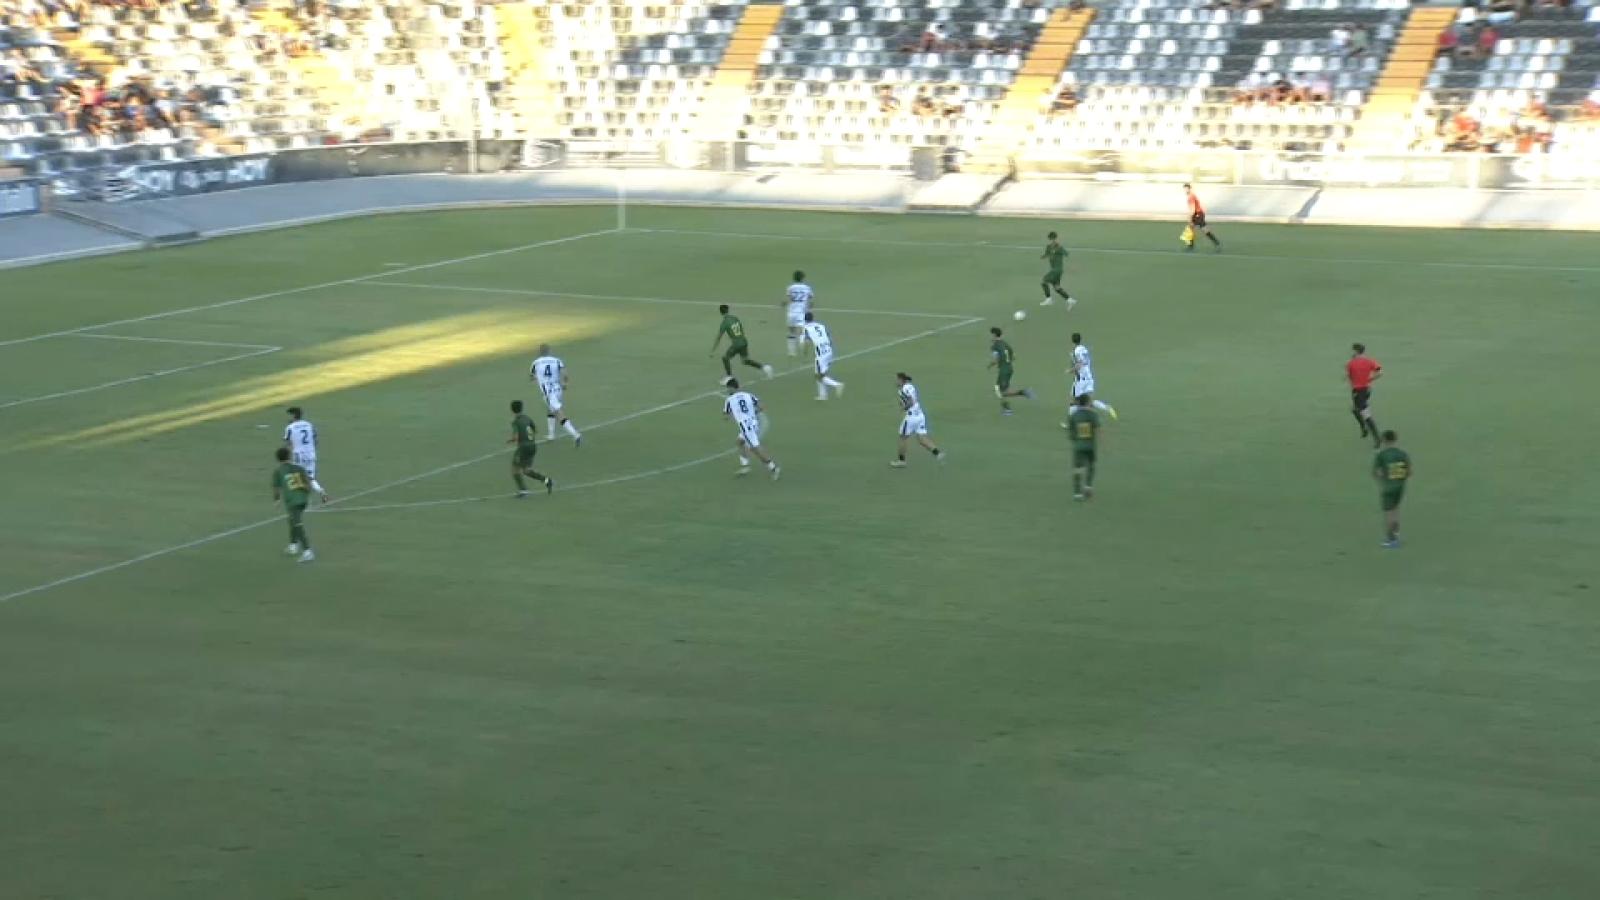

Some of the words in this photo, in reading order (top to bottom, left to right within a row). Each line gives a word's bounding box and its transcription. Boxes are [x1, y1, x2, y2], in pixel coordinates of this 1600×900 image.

[544, 364, 553, 377] 4
[739, 399, 749, 413] 8
[300, 429, 309, 444] 2
